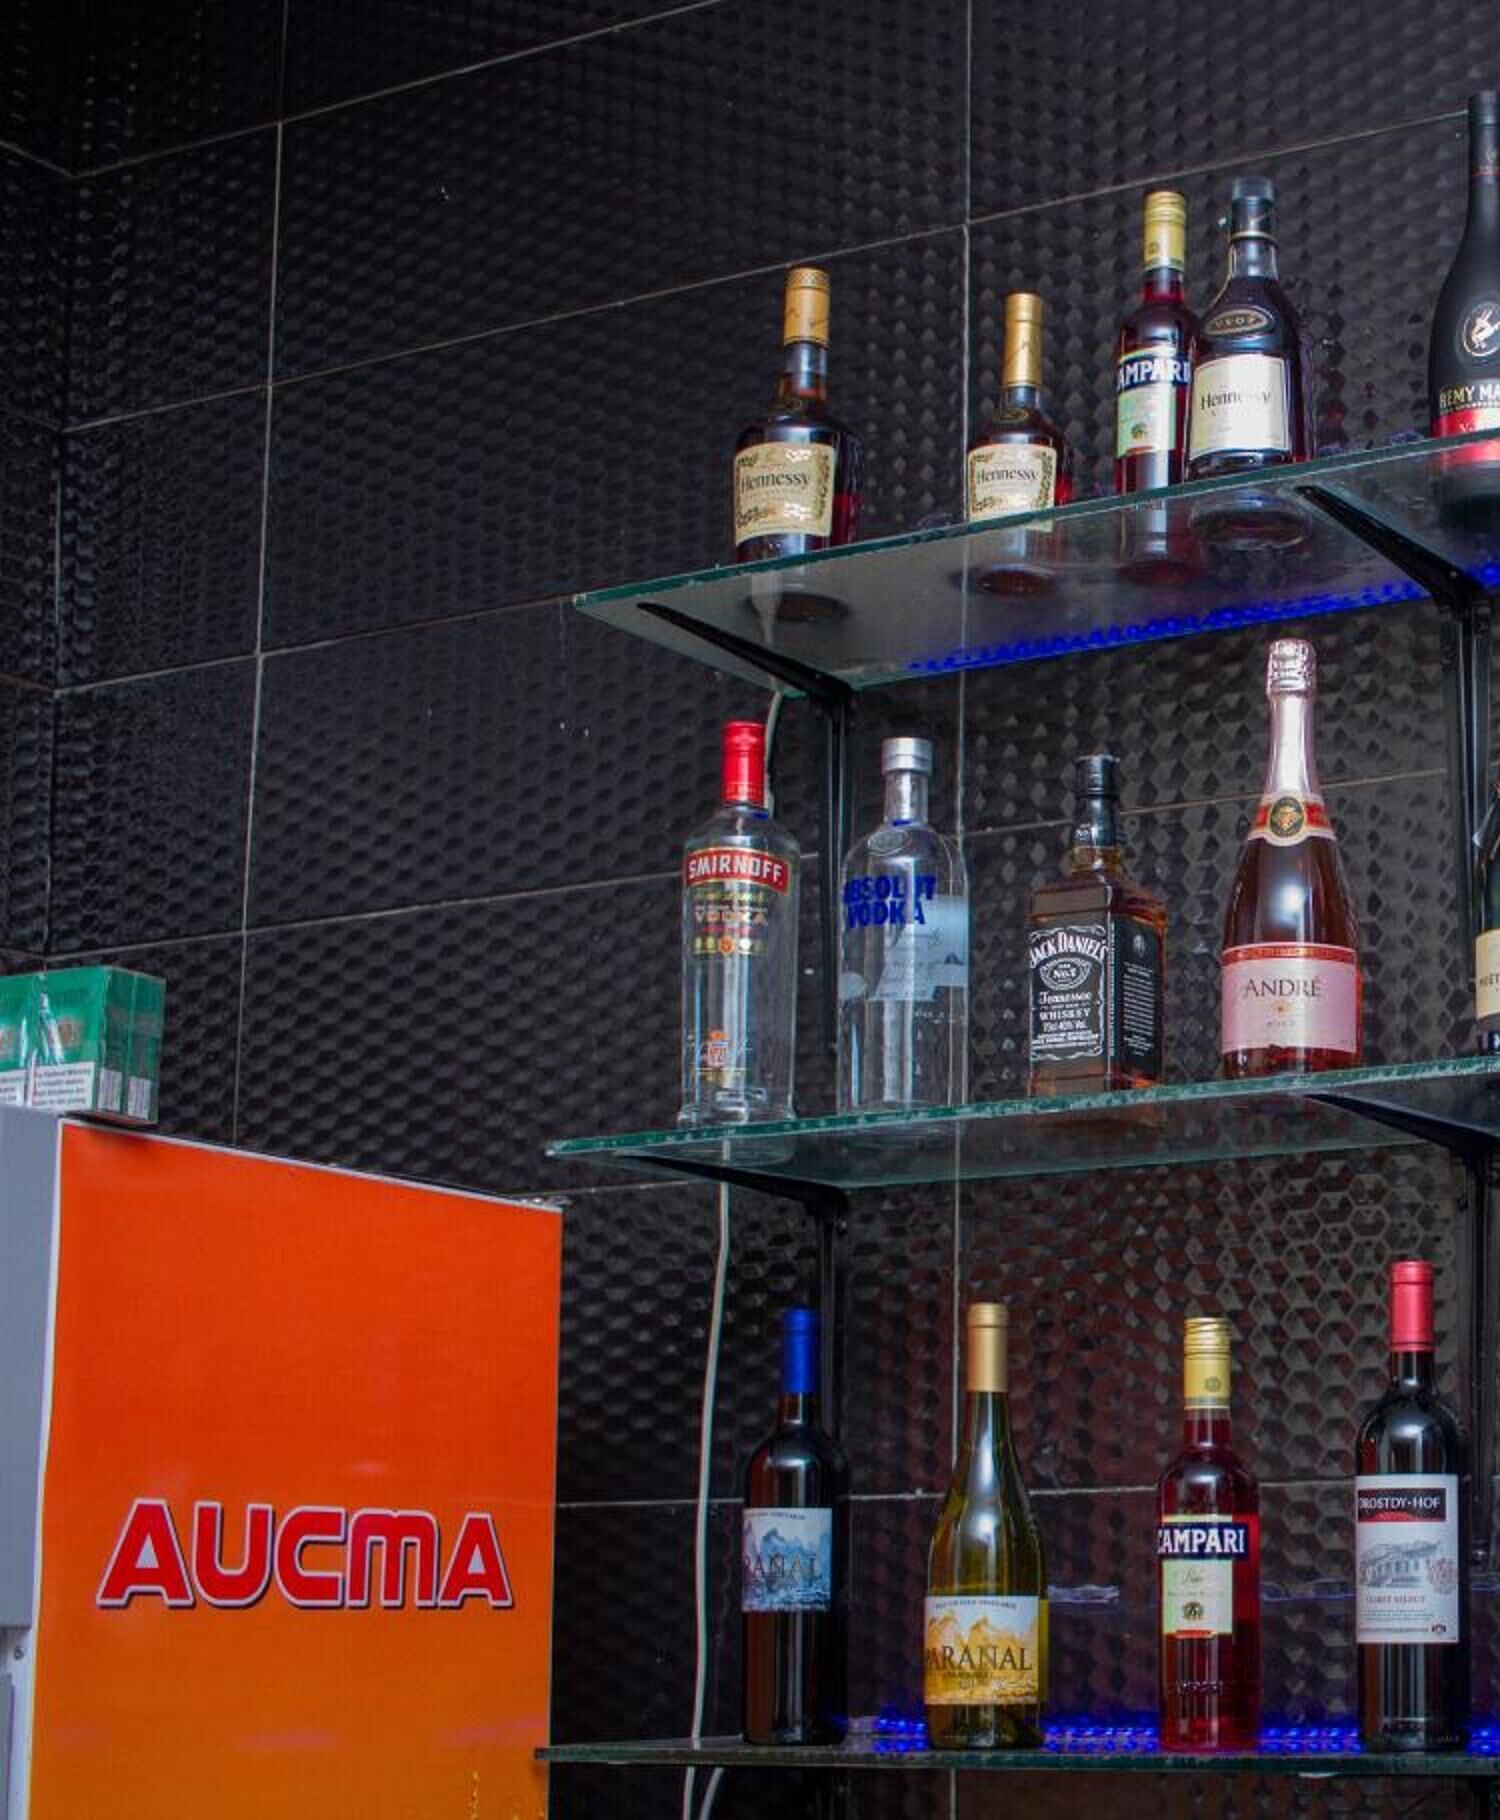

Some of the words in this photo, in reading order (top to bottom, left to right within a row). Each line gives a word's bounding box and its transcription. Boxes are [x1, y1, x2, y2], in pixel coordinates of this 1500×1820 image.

[1117, 359, 1190, 393] AMPARI
[741, 472, 810, 495] Hennessy
[688, 854, 783, 883] SMIRNOFF
[96, 1498, 514, 1609] AUCMA
